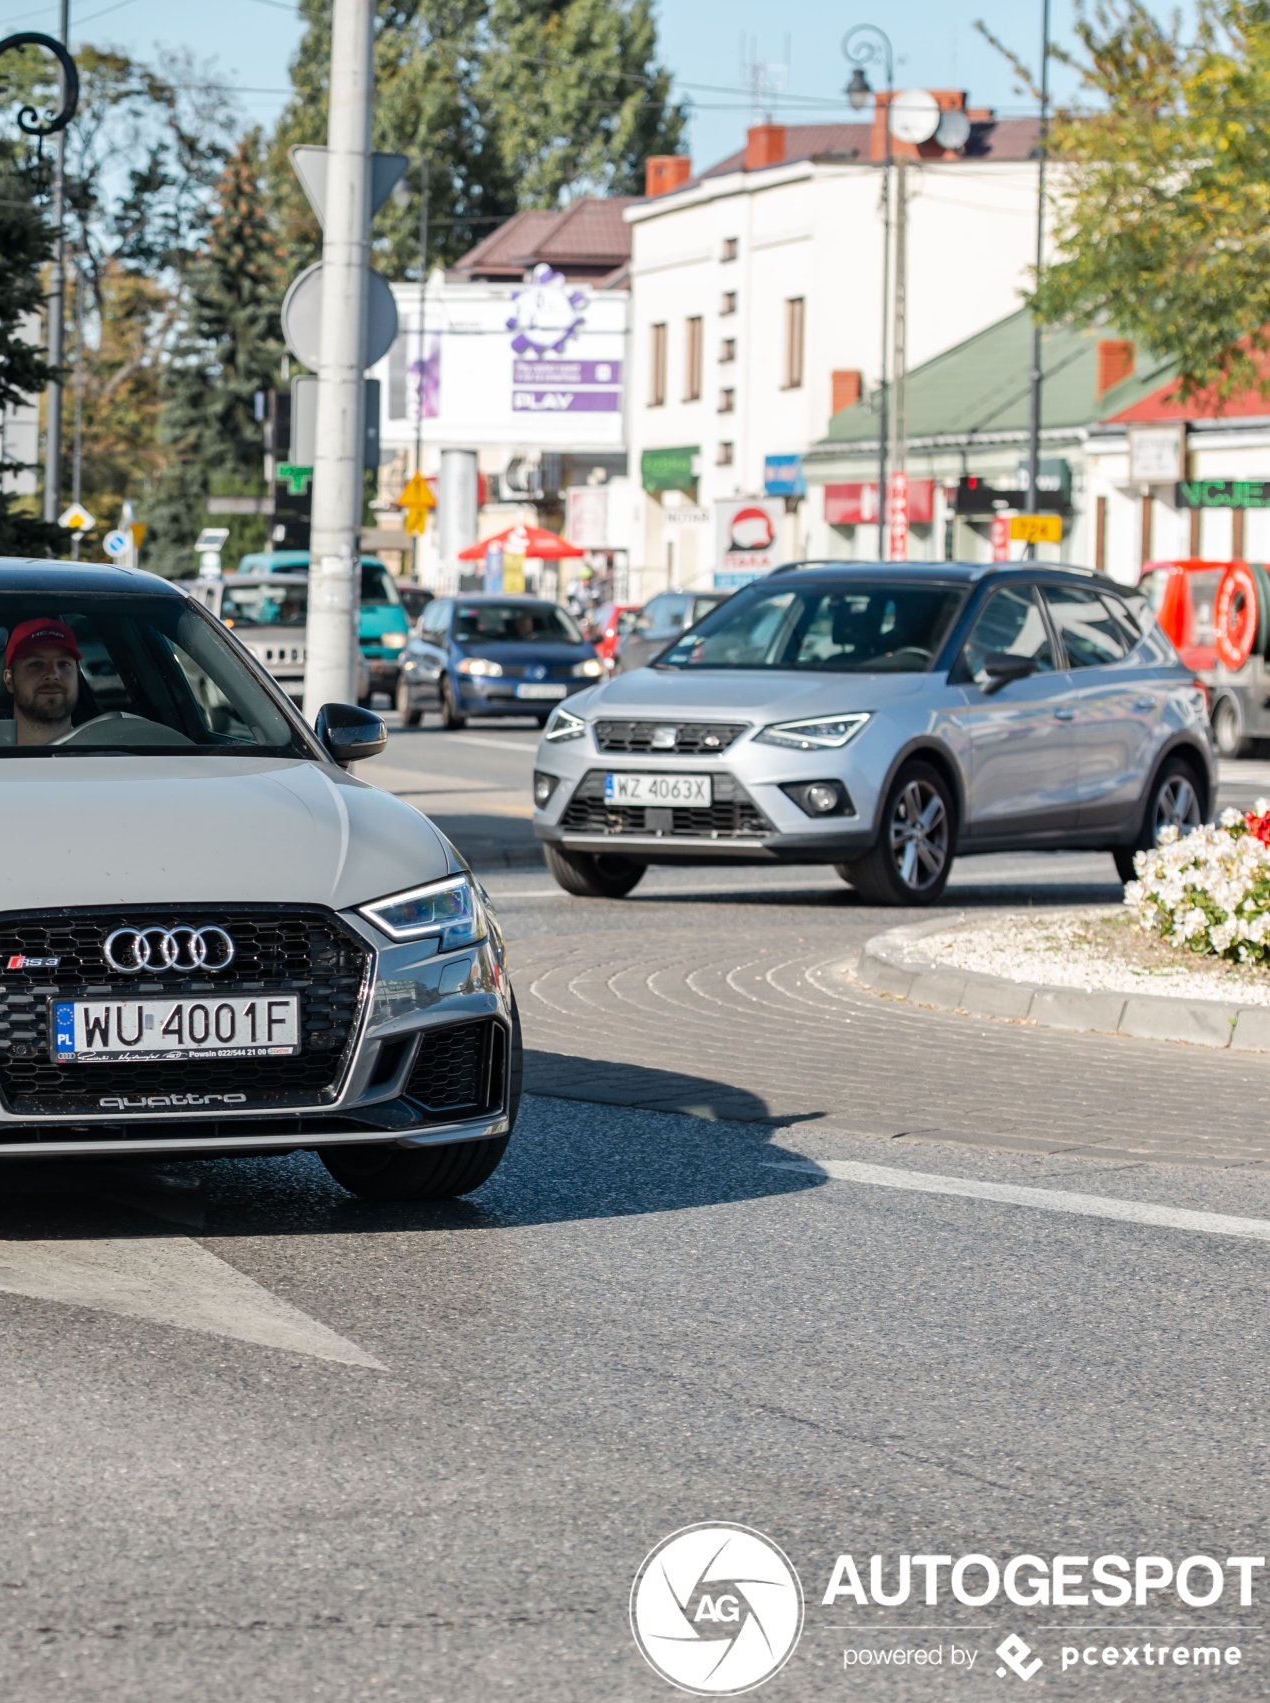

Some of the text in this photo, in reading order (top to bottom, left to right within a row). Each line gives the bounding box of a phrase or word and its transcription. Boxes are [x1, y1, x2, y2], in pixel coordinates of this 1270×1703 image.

[514, 391, 575, 411] PLAY
[31, 630, 65, 639] HEAD
[617, 779, 641, 798] WZ
[649, 780, 705, 799] 4063X
[16, 958, 59, 967] RS 3
[83, 1000, 291, 1048] WU 4001F
[57, 1034, 73, 1046] PL
[189, 1050, 217, 1058] Powsin
[217, 1048, 246, 1057] 022/544
[247, 1048, 256, 1056] 21
[257, 1047, 267, 1056] 00
[99, 1092, 247, 1110] quattro
